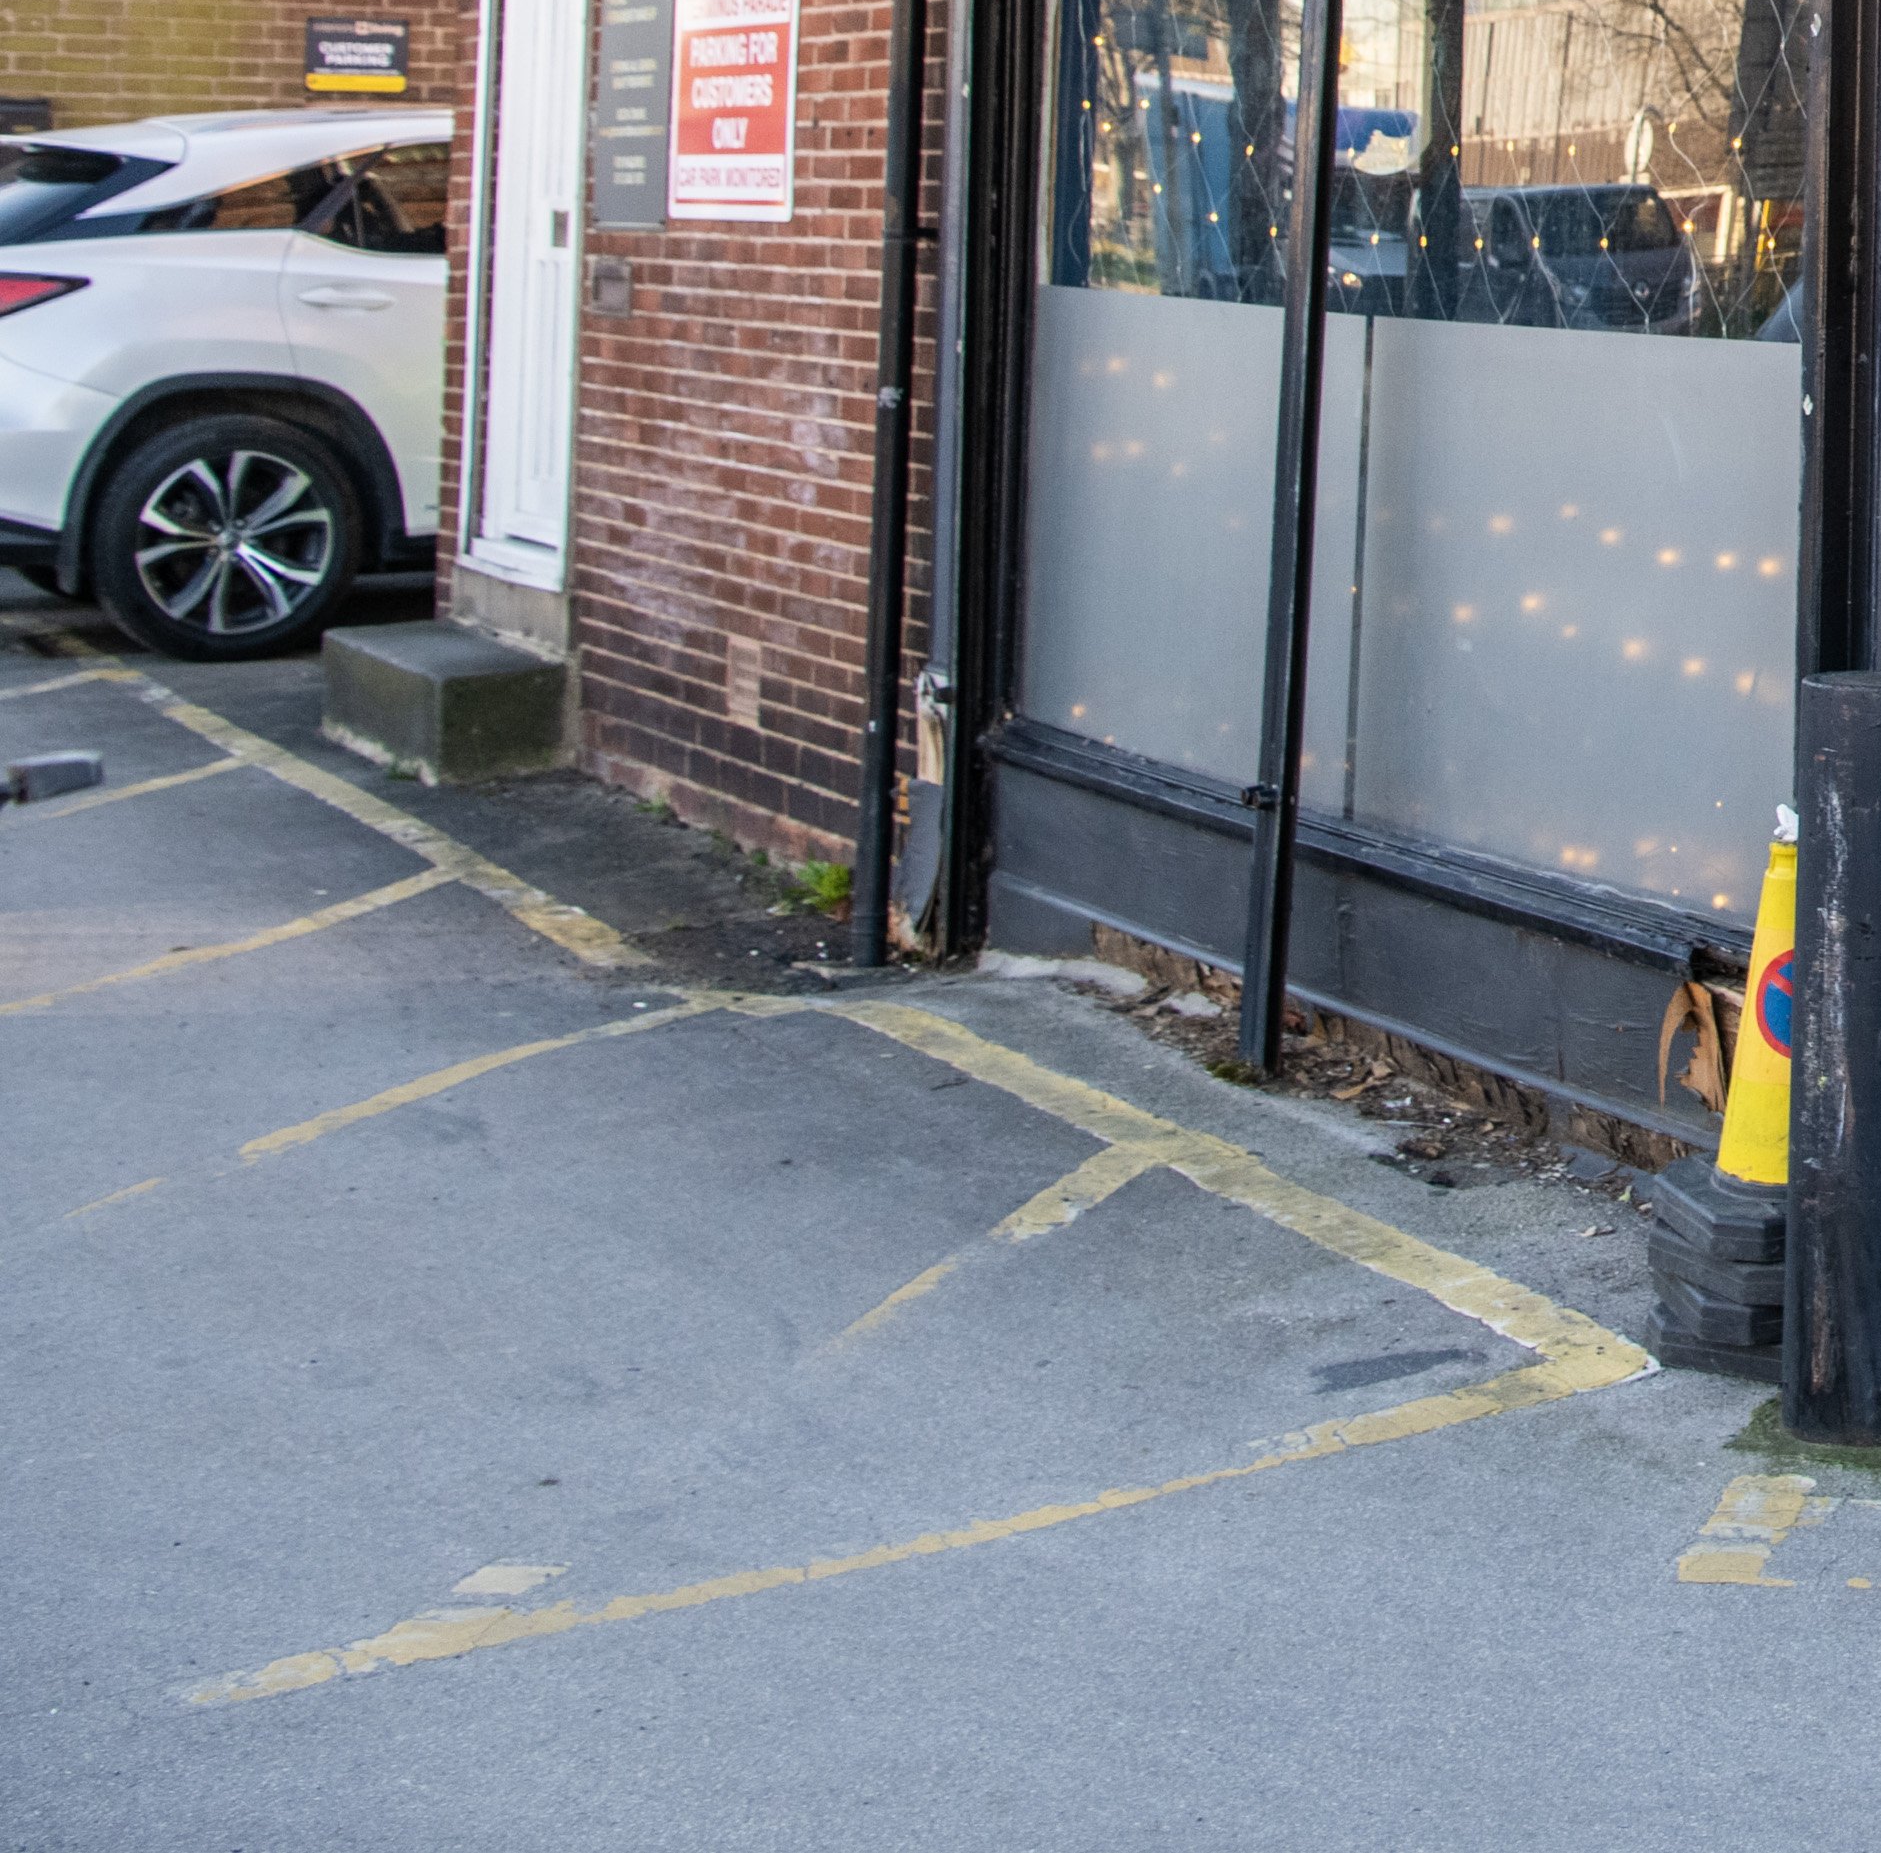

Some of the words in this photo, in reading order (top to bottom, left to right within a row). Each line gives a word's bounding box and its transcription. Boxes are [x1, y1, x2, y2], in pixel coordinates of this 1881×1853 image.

[689, 33, 748, 68] PARKING
[748, 31, 778, 65] FOR
[691, 73, 773, 109] CUSTOMERS
[711, 116, 749, 149] ONLY
[678, 167, 696, 187] CAR
[699, 167, 721, 187] PARK
[726, 167, 780, 188] MONITORED
